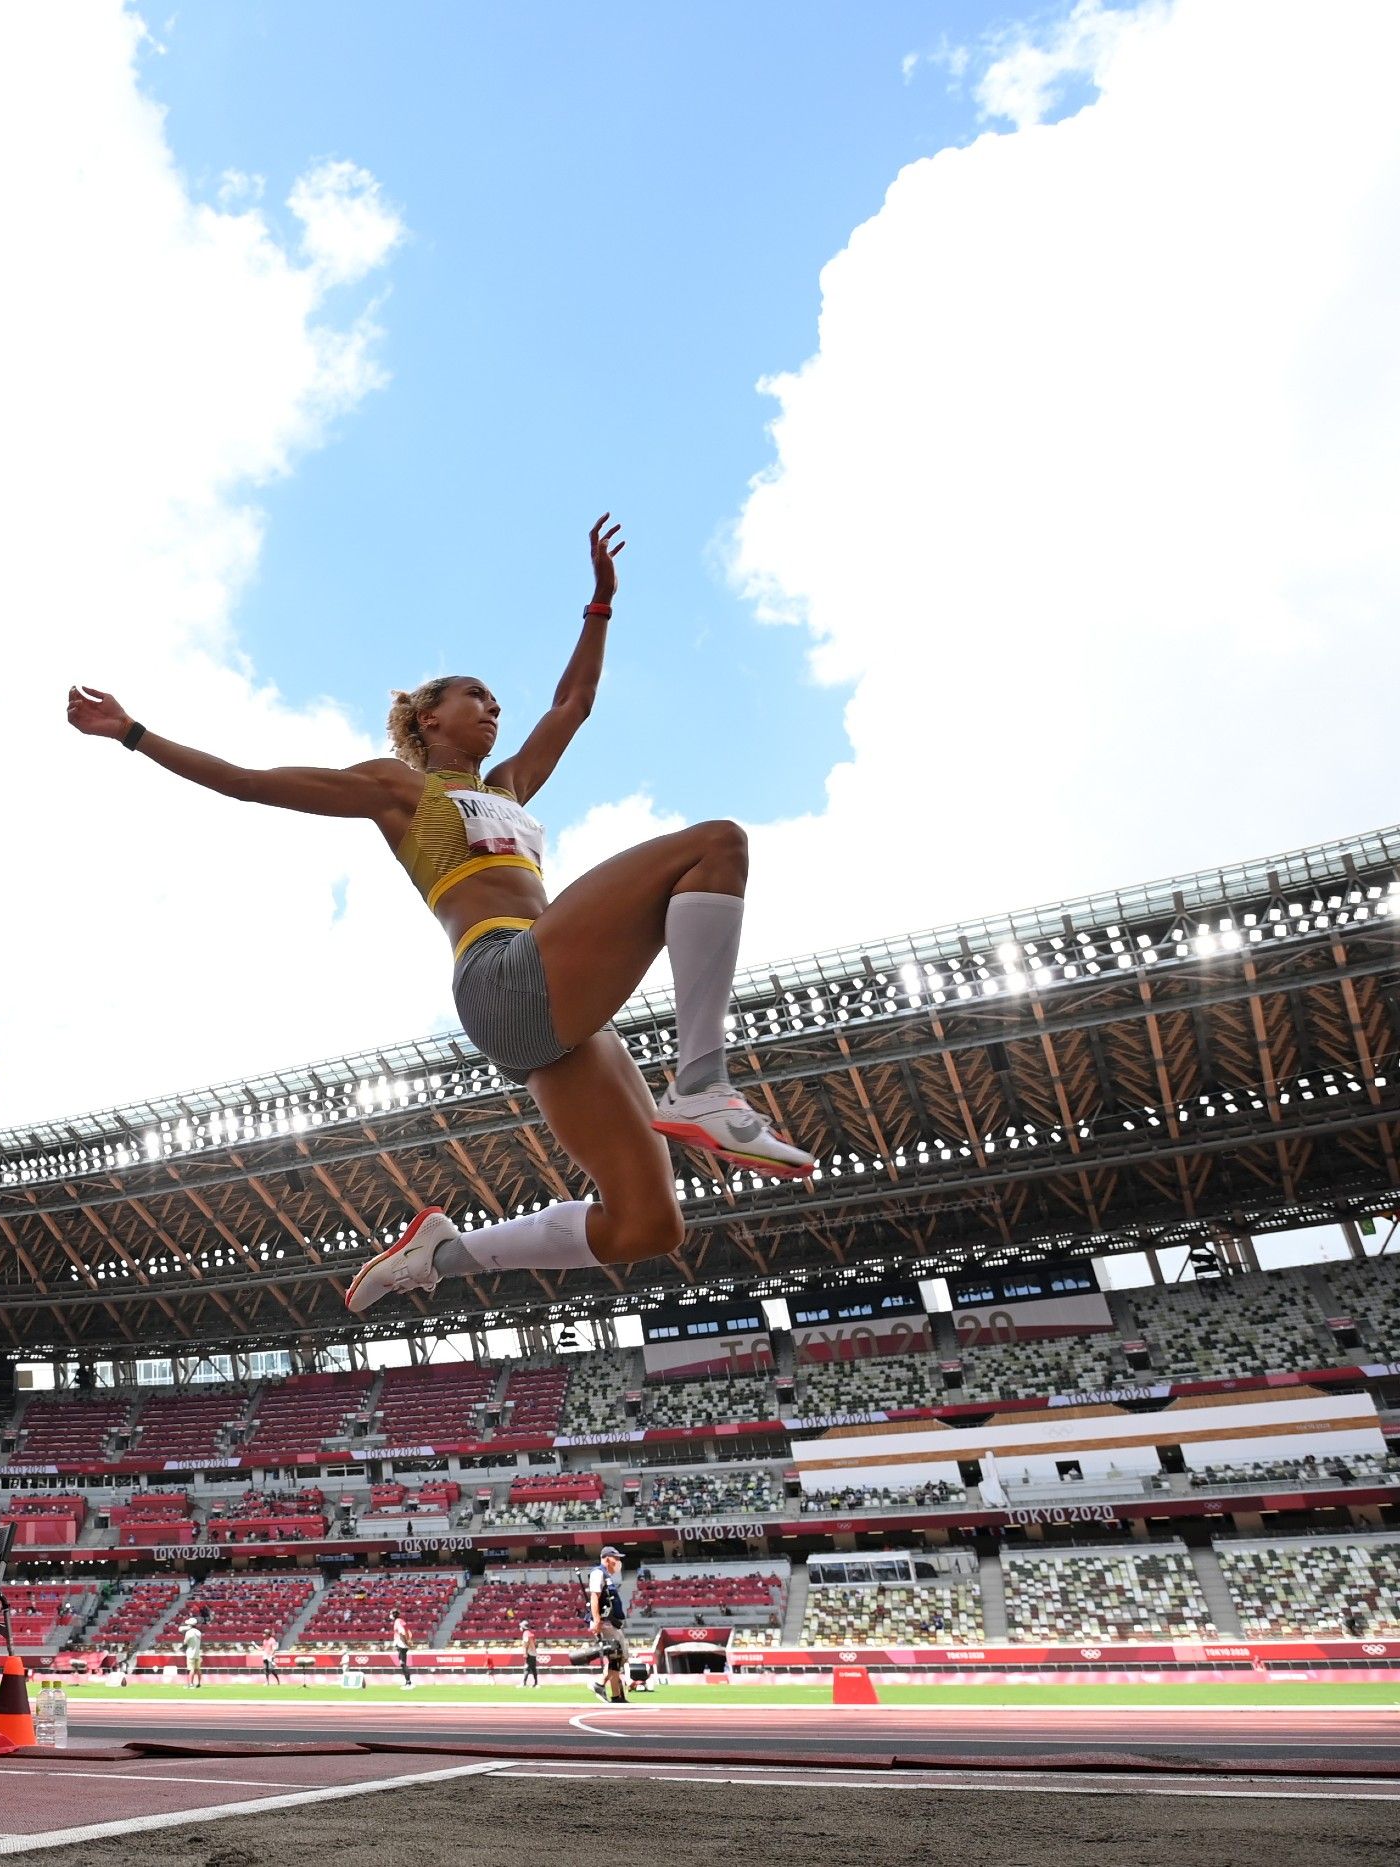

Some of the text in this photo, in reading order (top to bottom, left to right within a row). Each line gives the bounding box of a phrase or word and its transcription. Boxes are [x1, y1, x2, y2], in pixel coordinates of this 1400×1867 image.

[1066, 1386, 1151, 1405] TOKYO 2020
[800, 1413, 871, 1428] TOKYO 2020
[568, 1431, 630, 1446] TOKYO 2020
[364, 1446, 421, 1459] TOKYO 2020
[178, 1459, 229, 1469] TOKYO 2020
[1005, 1505, 1114, 1525] TOKYO 2020
[675, 1523, 764, 1540] TOKYO 2020
[397, 1537, 473, 1552] TOKYO 2020
[153, 1546, 220, 1559] TOKYO 2020
[1205, 1648, 1250, 1656] TOKYO 2020
